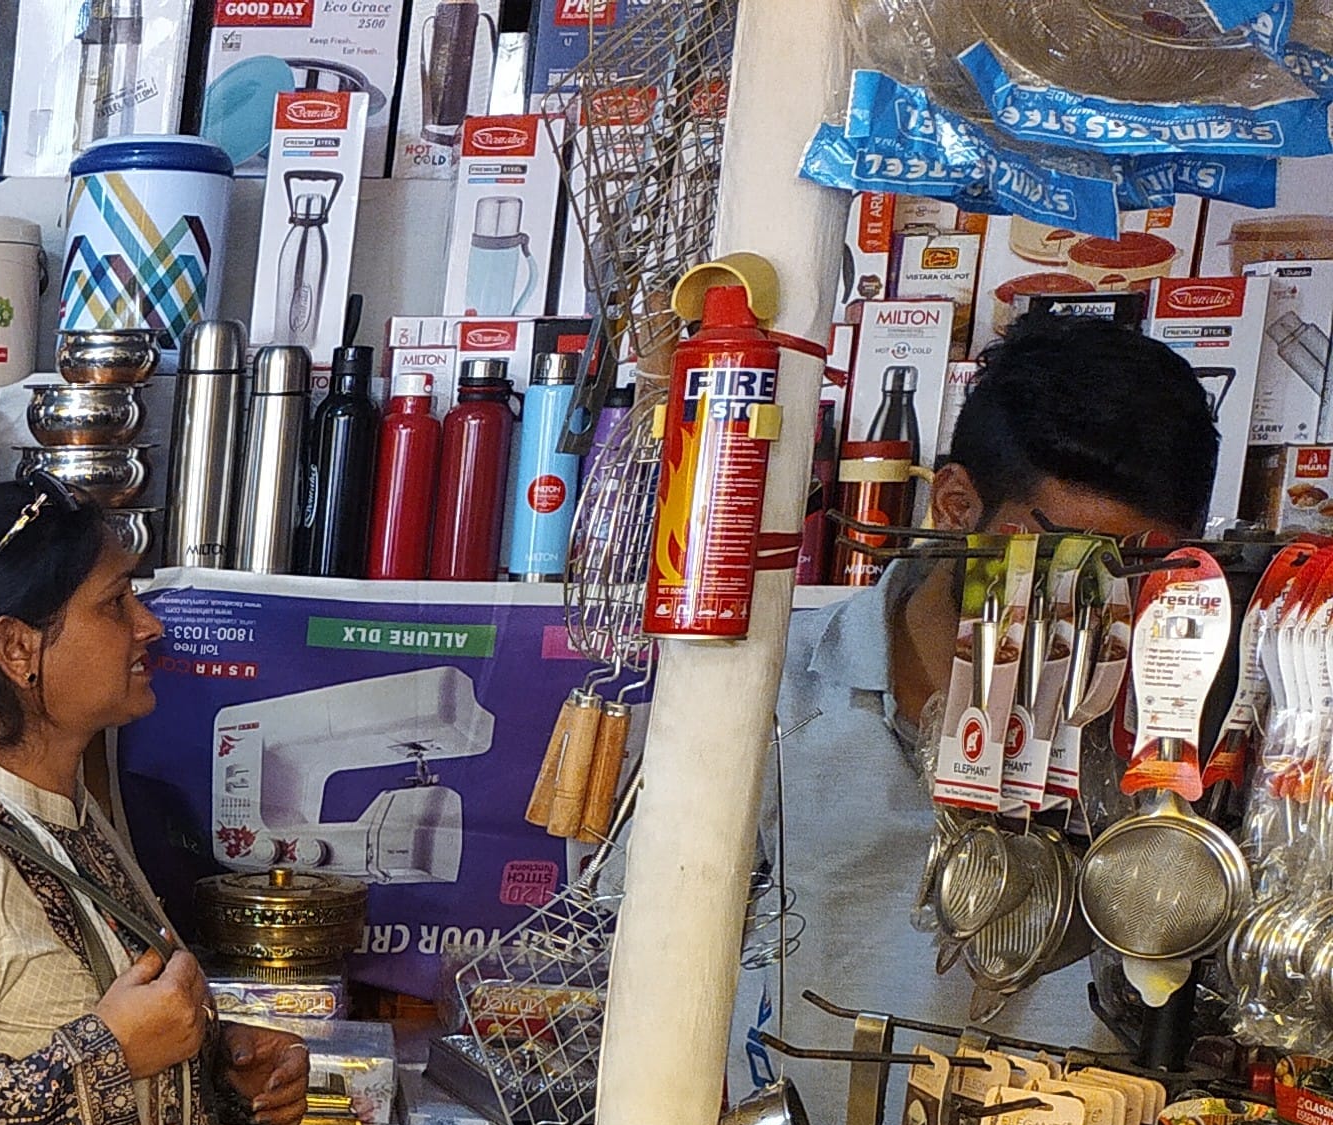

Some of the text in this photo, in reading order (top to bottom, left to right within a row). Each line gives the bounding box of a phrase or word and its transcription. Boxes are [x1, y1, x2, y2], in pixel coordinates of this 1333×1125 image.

[224, 2, 306, 17] GOOD DAY
[324, 0, 392, 14] Eco Grace
[357, 18, 385, 29] 2500
[406, 144, 432, 156] HOT
[413, 154, 446, 166] COLD
[905, 273, 939, 281] VISTARA
[1073, 304, 1112, 316] Dubblin
[876, 310, 940, 326] MILTON
[1203, 328, 1227, 336] STEEL
[401, 353, 447, 366] MILTON
[688, 370, 776, 397] FIRE
[948, 371, 977, 384] MIL
[712, 401, 752, 420] ST
[1252, 424, 1283, 434] CARRY
[1150, 592, 1222, 608] Prestige
[342, 626, 468, 649] ALLURE DLX
[173, 642, 219, 655] Toll free
[953, 762, 989, 777] ELEPHANT
[1004, 761, 1031, 773] PHANT
[509, 863, 554, 873] functions
[507, 872, 552, 884] STITCH
[418, 925, 501, 954] YOUR
